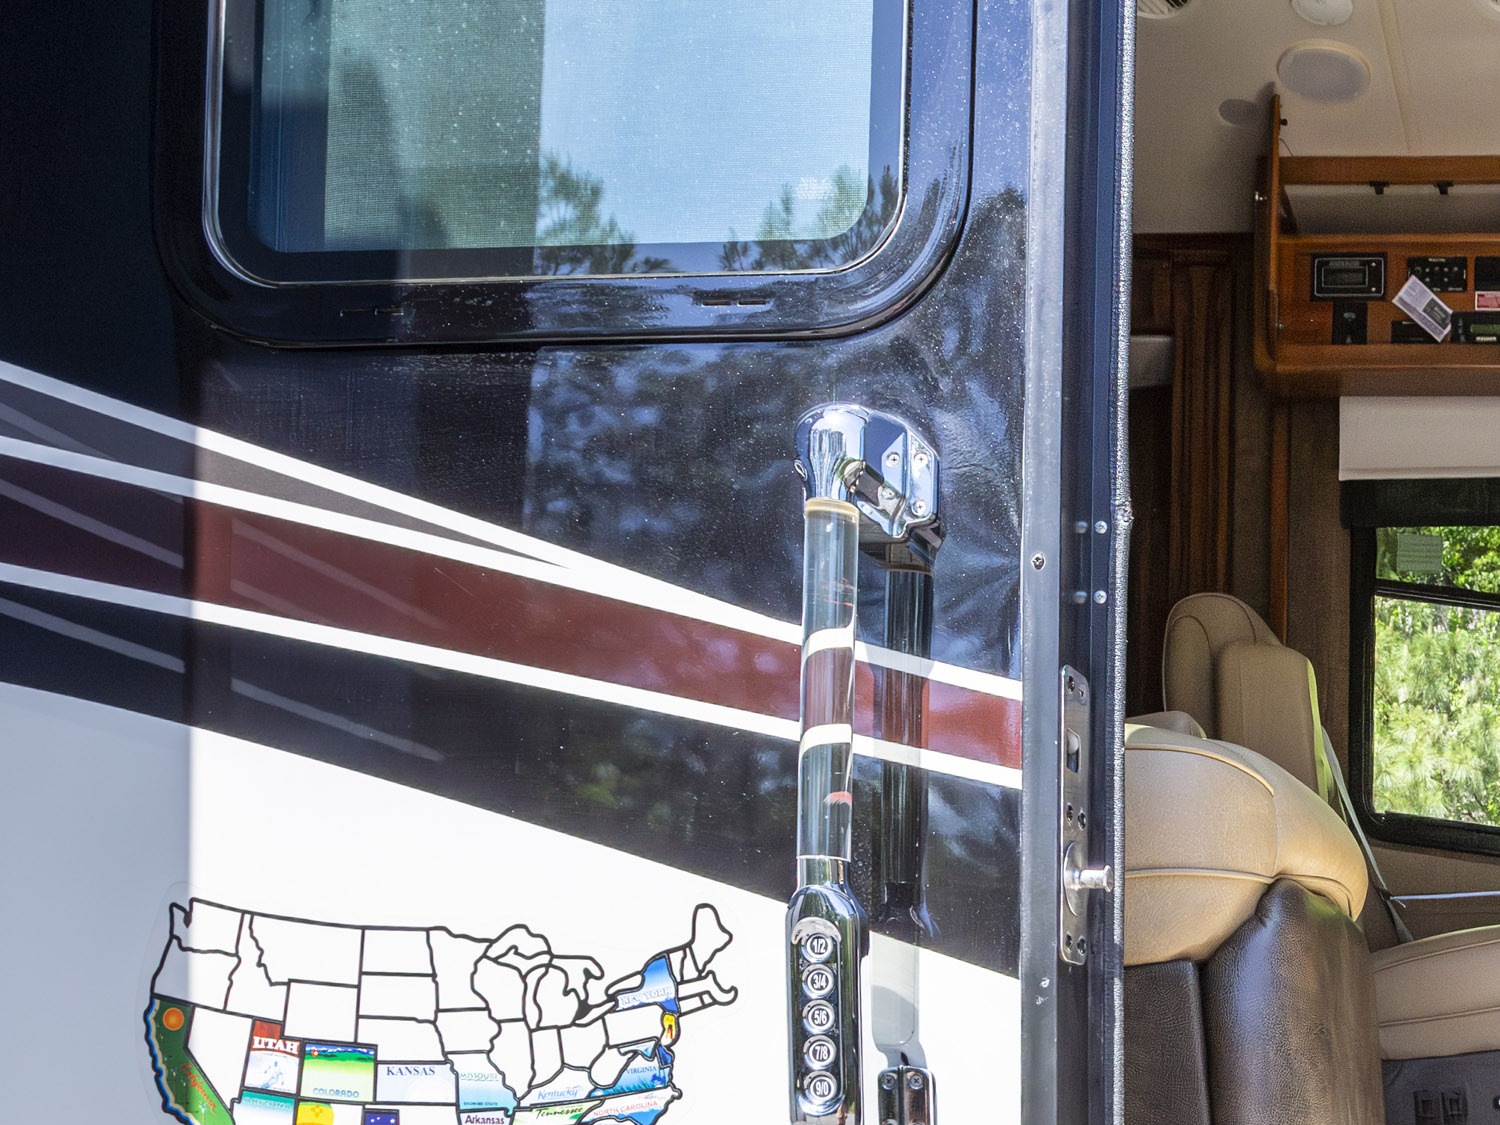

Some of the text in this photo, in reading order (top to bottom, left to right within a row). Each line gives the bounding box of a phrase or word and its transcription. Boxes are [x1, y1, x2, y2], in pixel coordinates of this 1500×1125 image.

[812, 939, 826, 953] 1/2
[813, 975, 827, 989] 3/4
[620, 986, 672, 1005] NEW YORK
[814, 1010, 828, 1024] 5/6
[252, 1036, 299, 1054] UTAH
[815, 1046, 829, 1060] 7/8
[386, 1066, 435, 1076] KANSAS
[460, 1072, 498, 1080] MISSOURI
[626, 1066, 657, 1075] VIRGINIA
[180, 1063, 217, 1116] California
[313, 1088, 360, 1099] COLORADO
[537, 1088, 579, 1099] Kentucky
[816, 1081, 829, 1095] 9/0
[534, 1107, 583, 1119] Tennessee
[594, 1101, 658, 1117] NORTH CAROLINA
[465, 1114, 505, 1125] Arkansas
